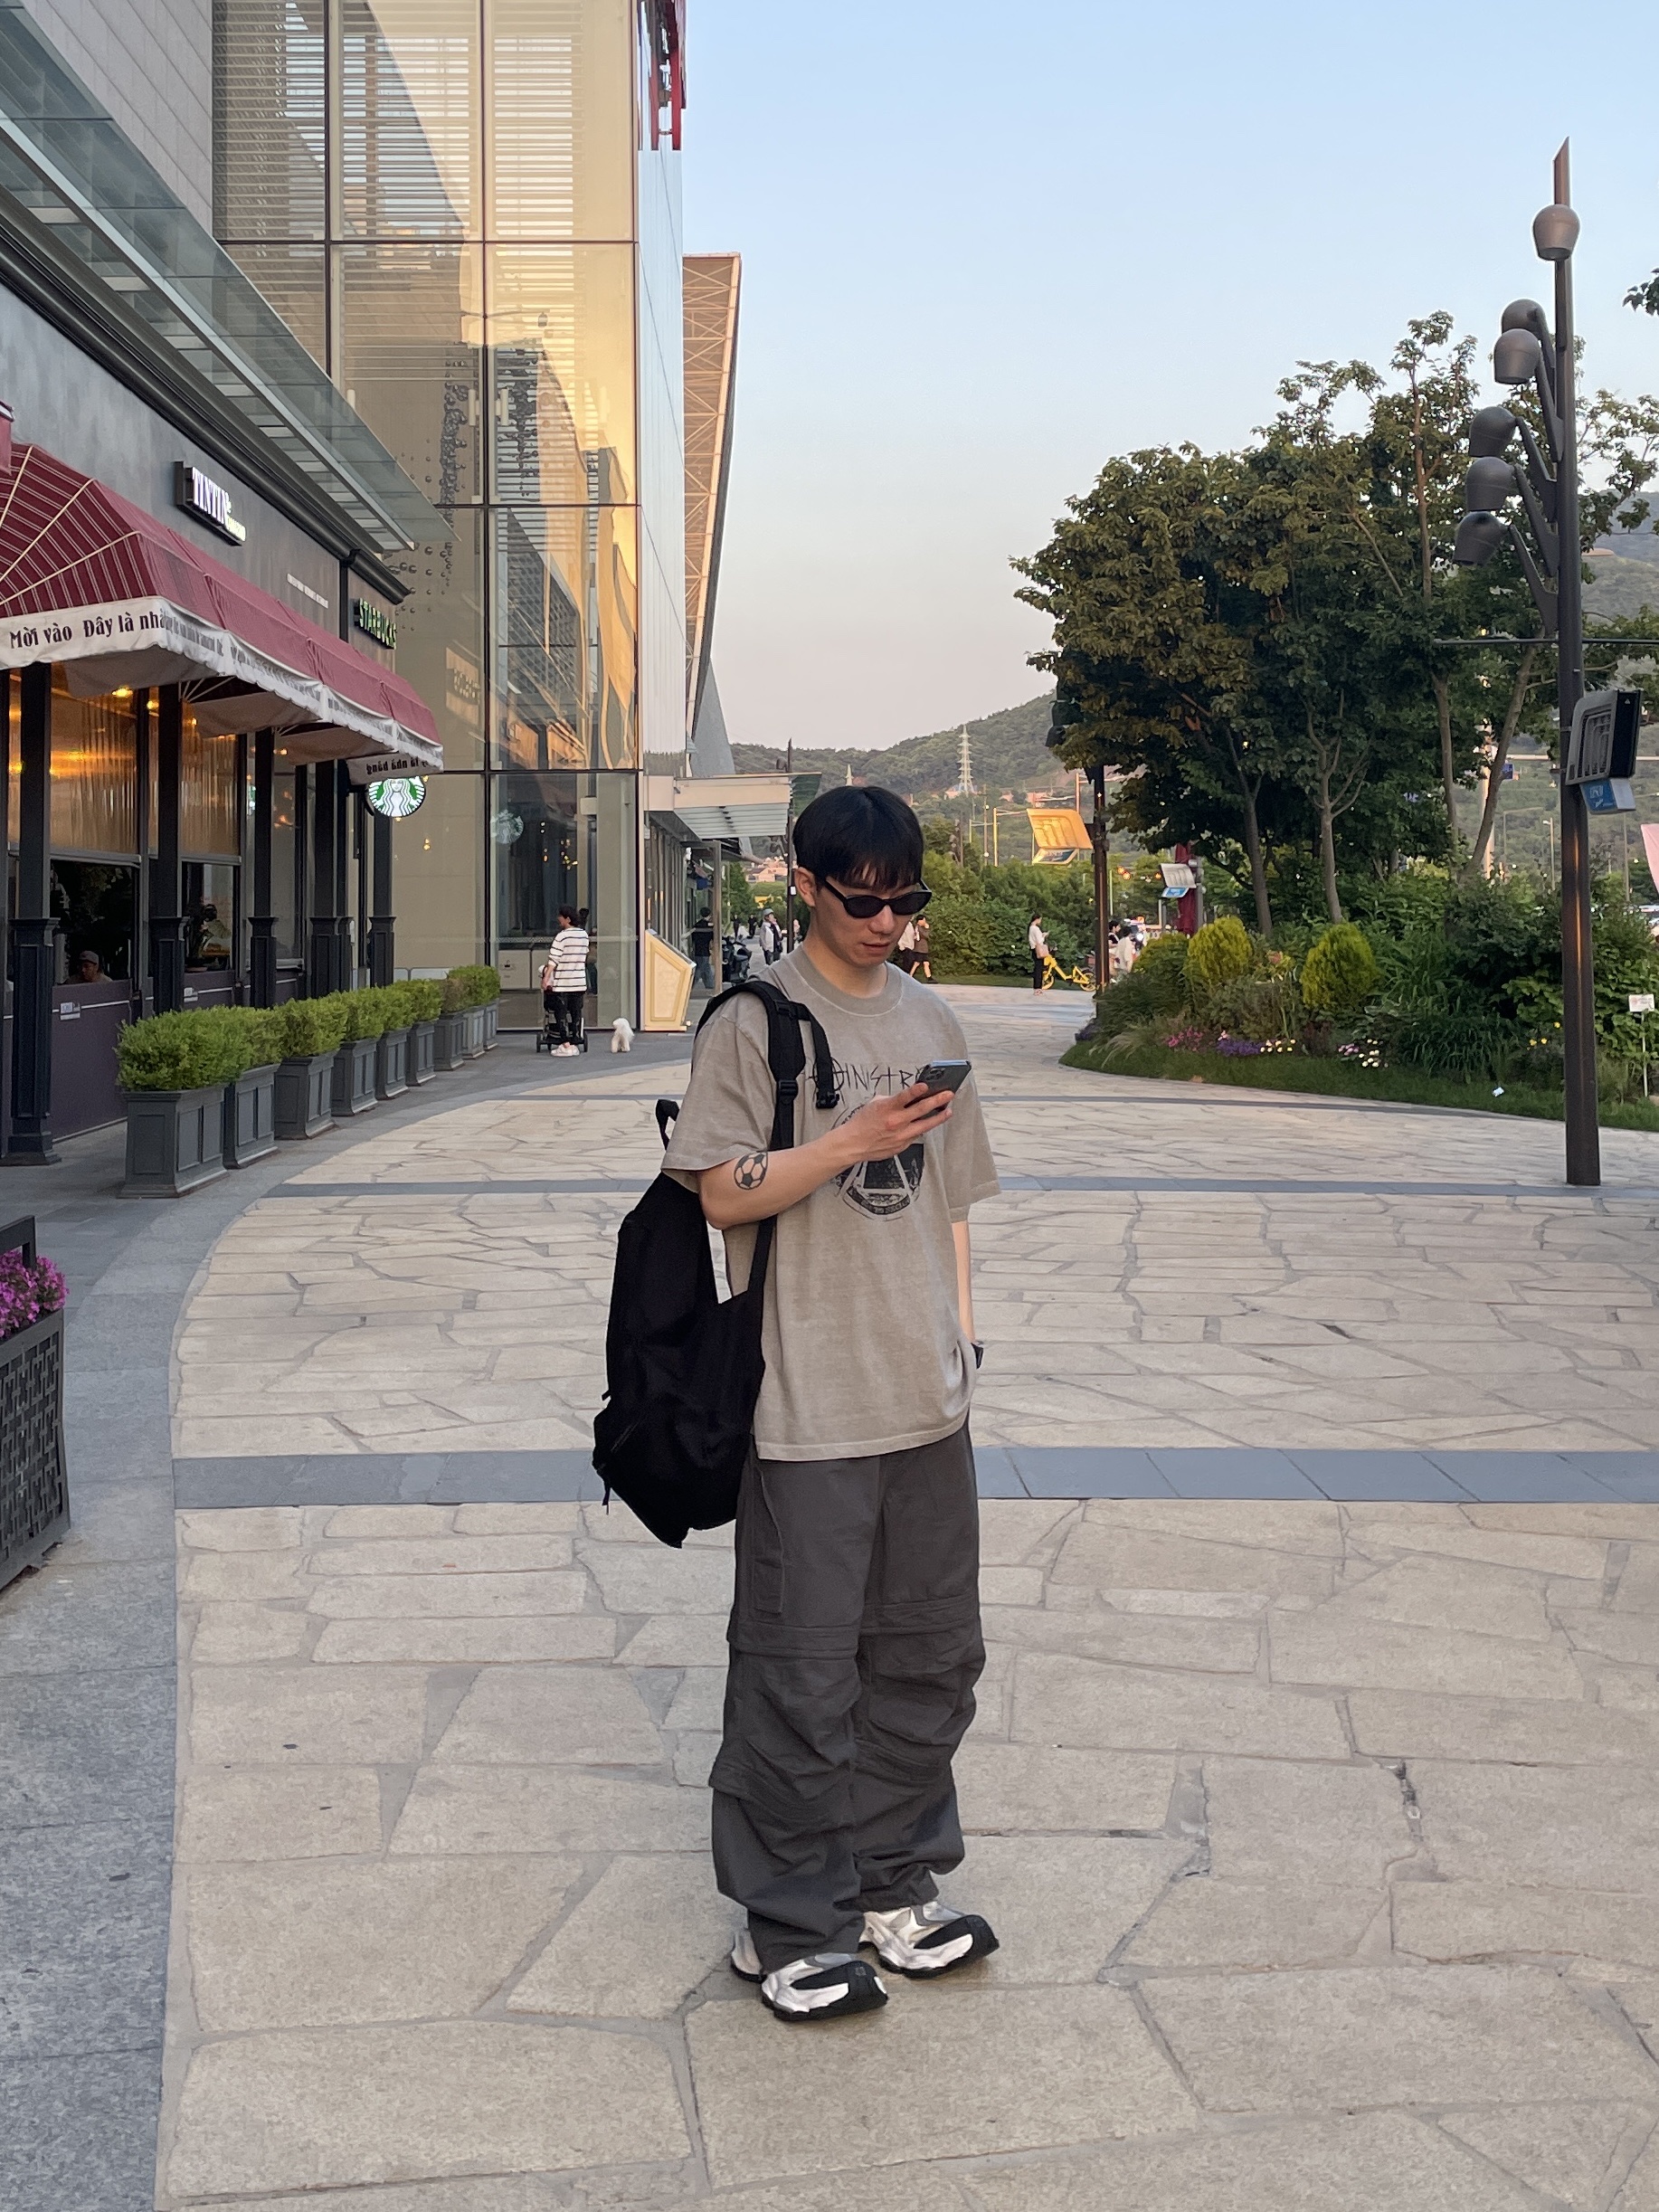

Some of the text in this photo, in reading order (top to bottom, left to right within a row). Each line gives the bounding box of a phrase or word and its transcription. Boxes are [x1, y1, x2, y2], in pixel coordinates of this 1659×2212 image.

[43, 622, 73, 644] vào
[82, 616, 113, 638] Đây
[118, 612, 134, 633] là
[359, 596, 397, 650] STARBUCKS
